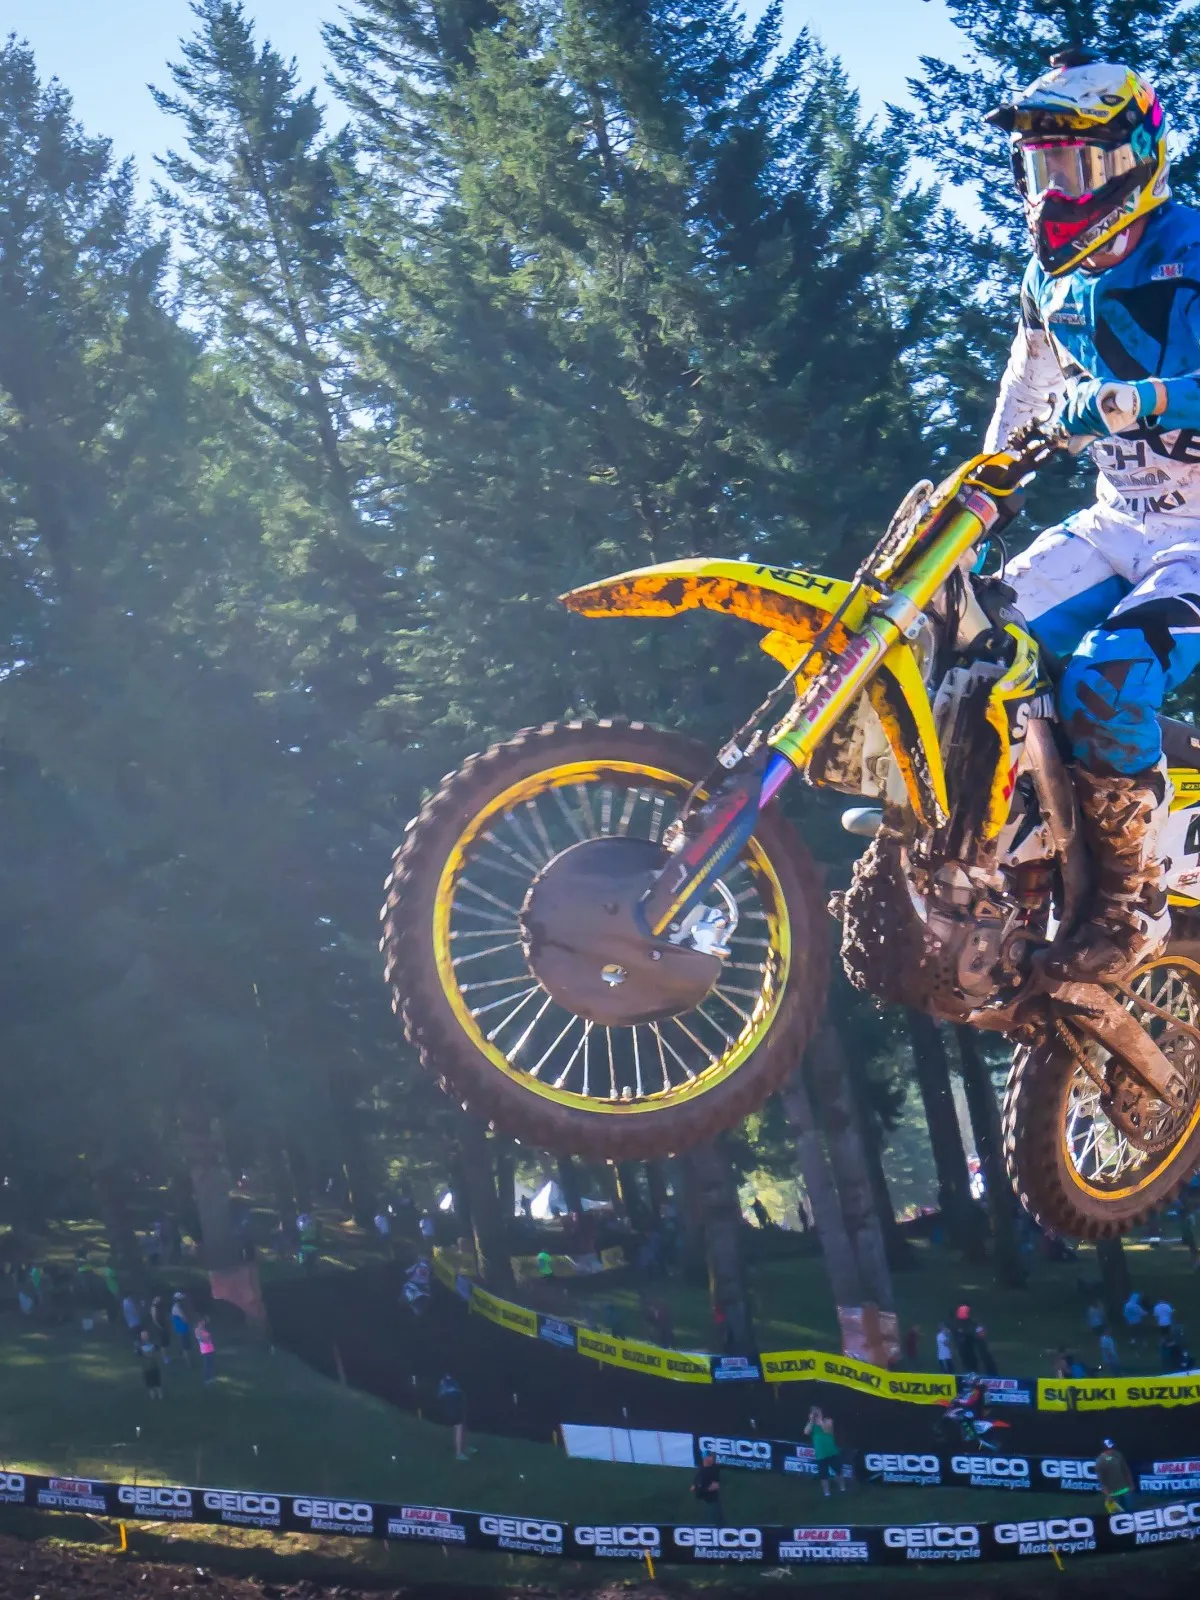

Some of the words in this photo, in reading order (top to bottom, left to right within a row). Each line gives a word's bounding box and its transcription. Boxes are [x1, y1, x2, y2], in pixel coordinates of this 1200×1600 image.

[765, 1358, 816, 1374] SUZUKI
[824, 1361, 881, 1388] SUZUKI
[888, 1380, 952, 1396] SUZUKI
[698, 1437, 771, 1459] GEICO
[865, 1454, 939, 1472] GEICO
[951, 1456, 1028, 1476] GEICO
[1041, 1460, 1098, 1479] GEIC
[118, 1486, 192, 1507] GEICO
[203, 1492, 280, 1515] GEICO
[293, 1499, 373, 1522] GEICO
[480, 1516, 562, 1542] GEICO
[574, 1527, 660, 1546] GEICO
[674, 1527, 762, 1547] GEICO
[797, 1530, 829, 1541] LUCAS
[884, 1526, 979, 1547] GEICO
[994, 1518, 1094, 1544] GEICO
[779, 1546, 868, 1558] MOTOCROSS
[907, 1547, 981, 1561] Motorcycle
